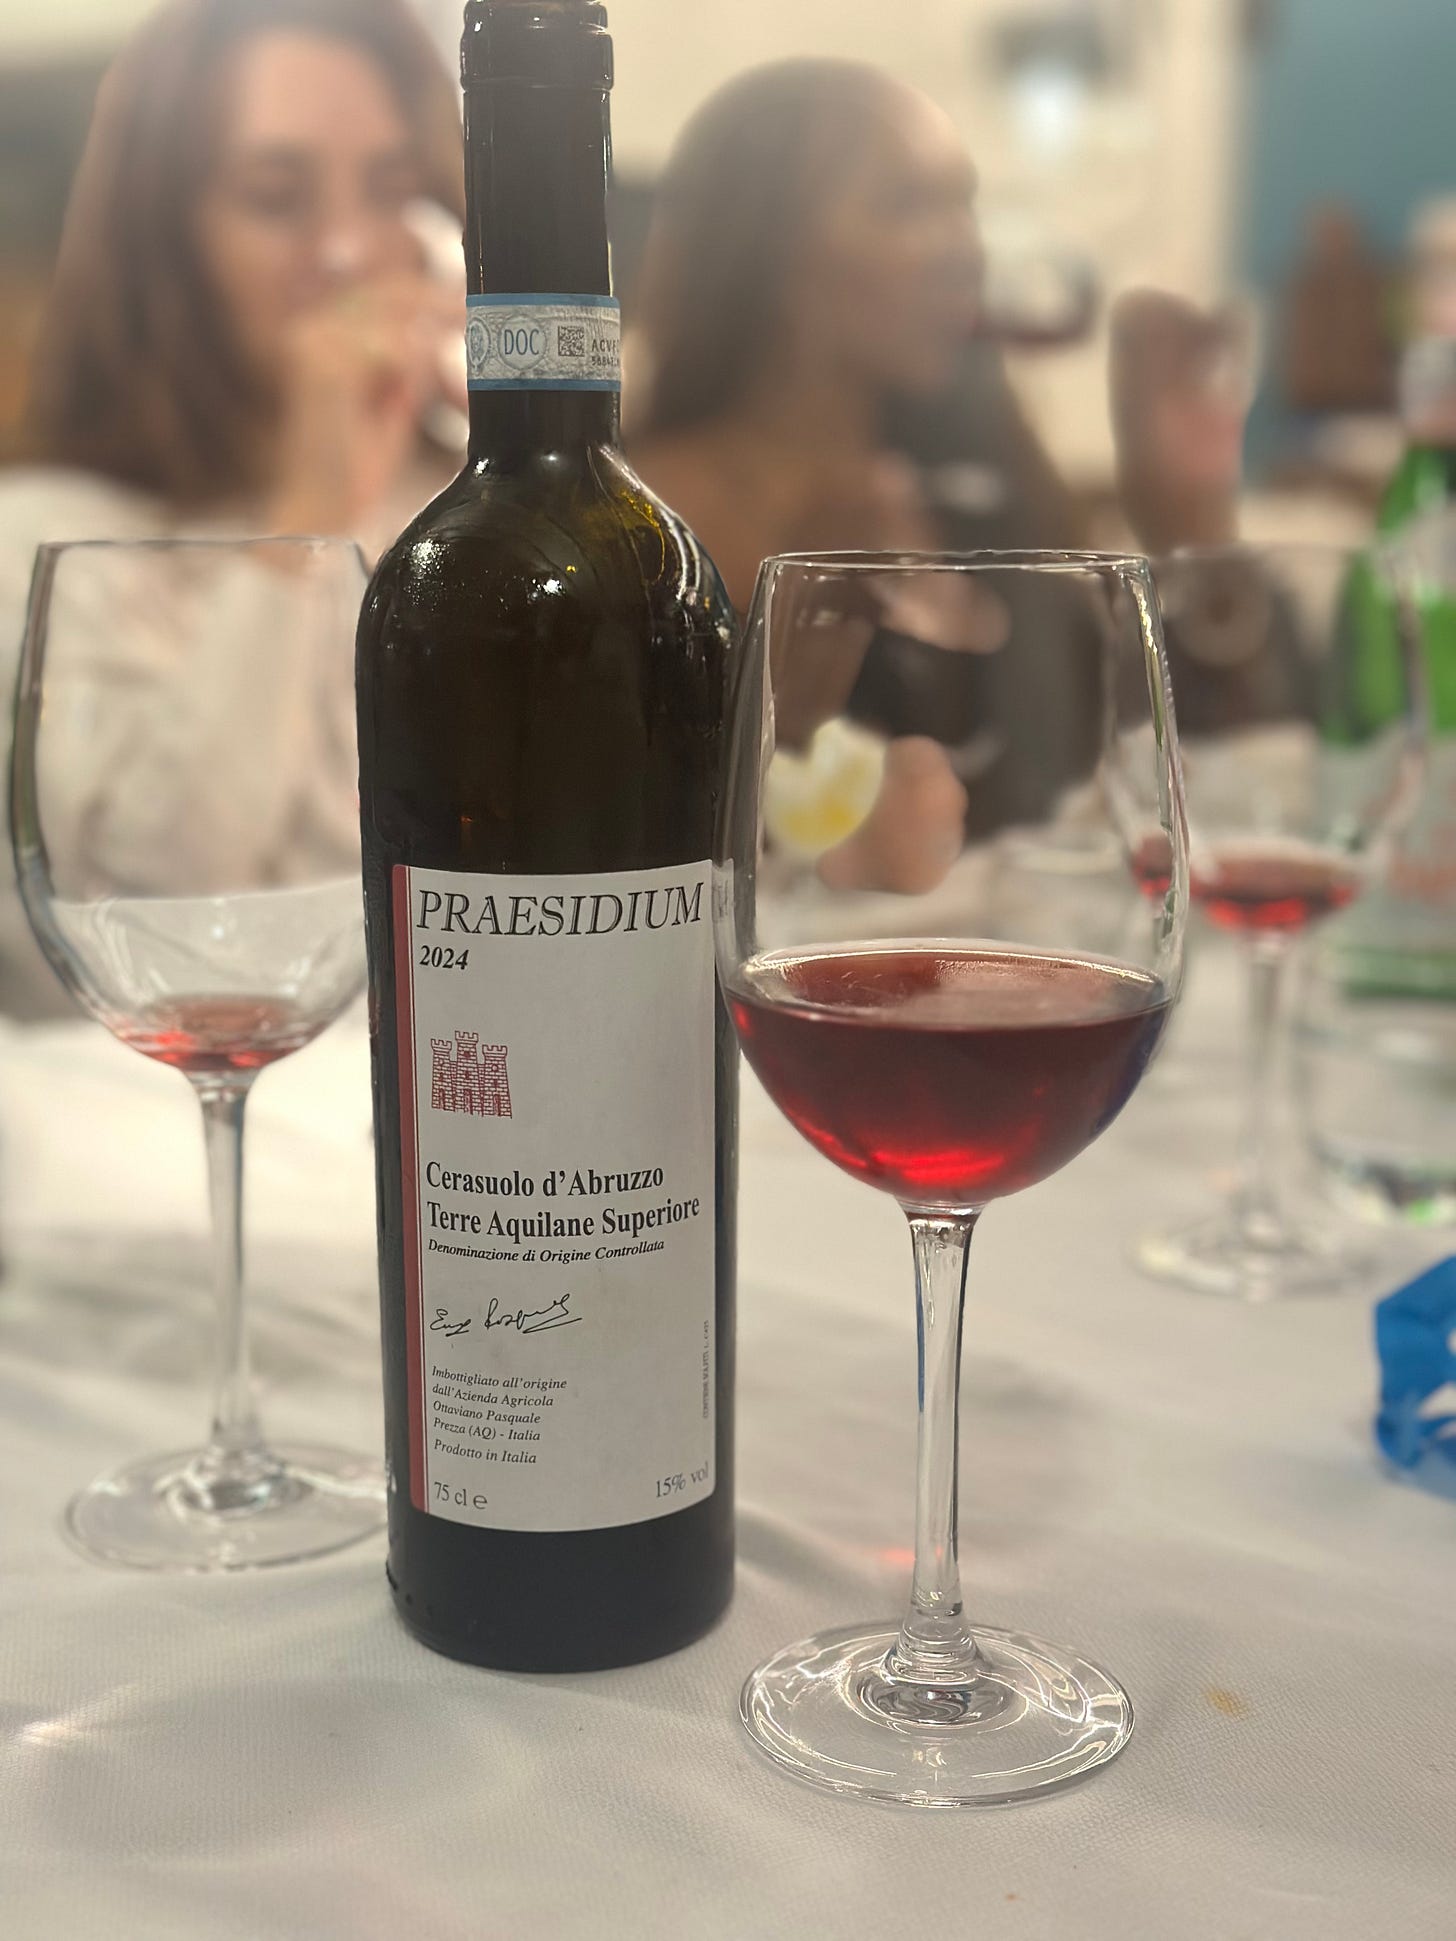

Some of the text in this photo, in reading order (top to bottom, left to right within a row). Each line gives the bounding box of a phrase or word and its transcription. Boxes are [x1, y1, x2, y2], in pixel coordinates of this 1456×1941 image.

[504, 329, 540, 355] DOC
[416, 881, 704, 937] PRAESIDIUM
[419, 945, 470, 970] 2024
[426, 1161, 535, 1197] Cerasuolo
[427, 1197, 701, 1244] Terre Aquilane Superiore
[428, 1238, 665, 1265] Denominazione di Origine Controllata
[432, 1366, 500, 1389] Imbottigliato
[433, 1400, 541, 1425] Ottaviano Pasquale
[501, 1393, 554, 1408] Agricola
[433, 1417, 466, 1434] Prezza
[468, 1424, 497, 1441] (AQ)
[507, 1429, 541, 1441] Italia
[434, 1438, 537, 1464] Prodotto in Italia
[655, 1461, 710, 1499] 15% vol
[434, 1481, 451, 1502] 75
[454, 1489, 468, 1507] cl
